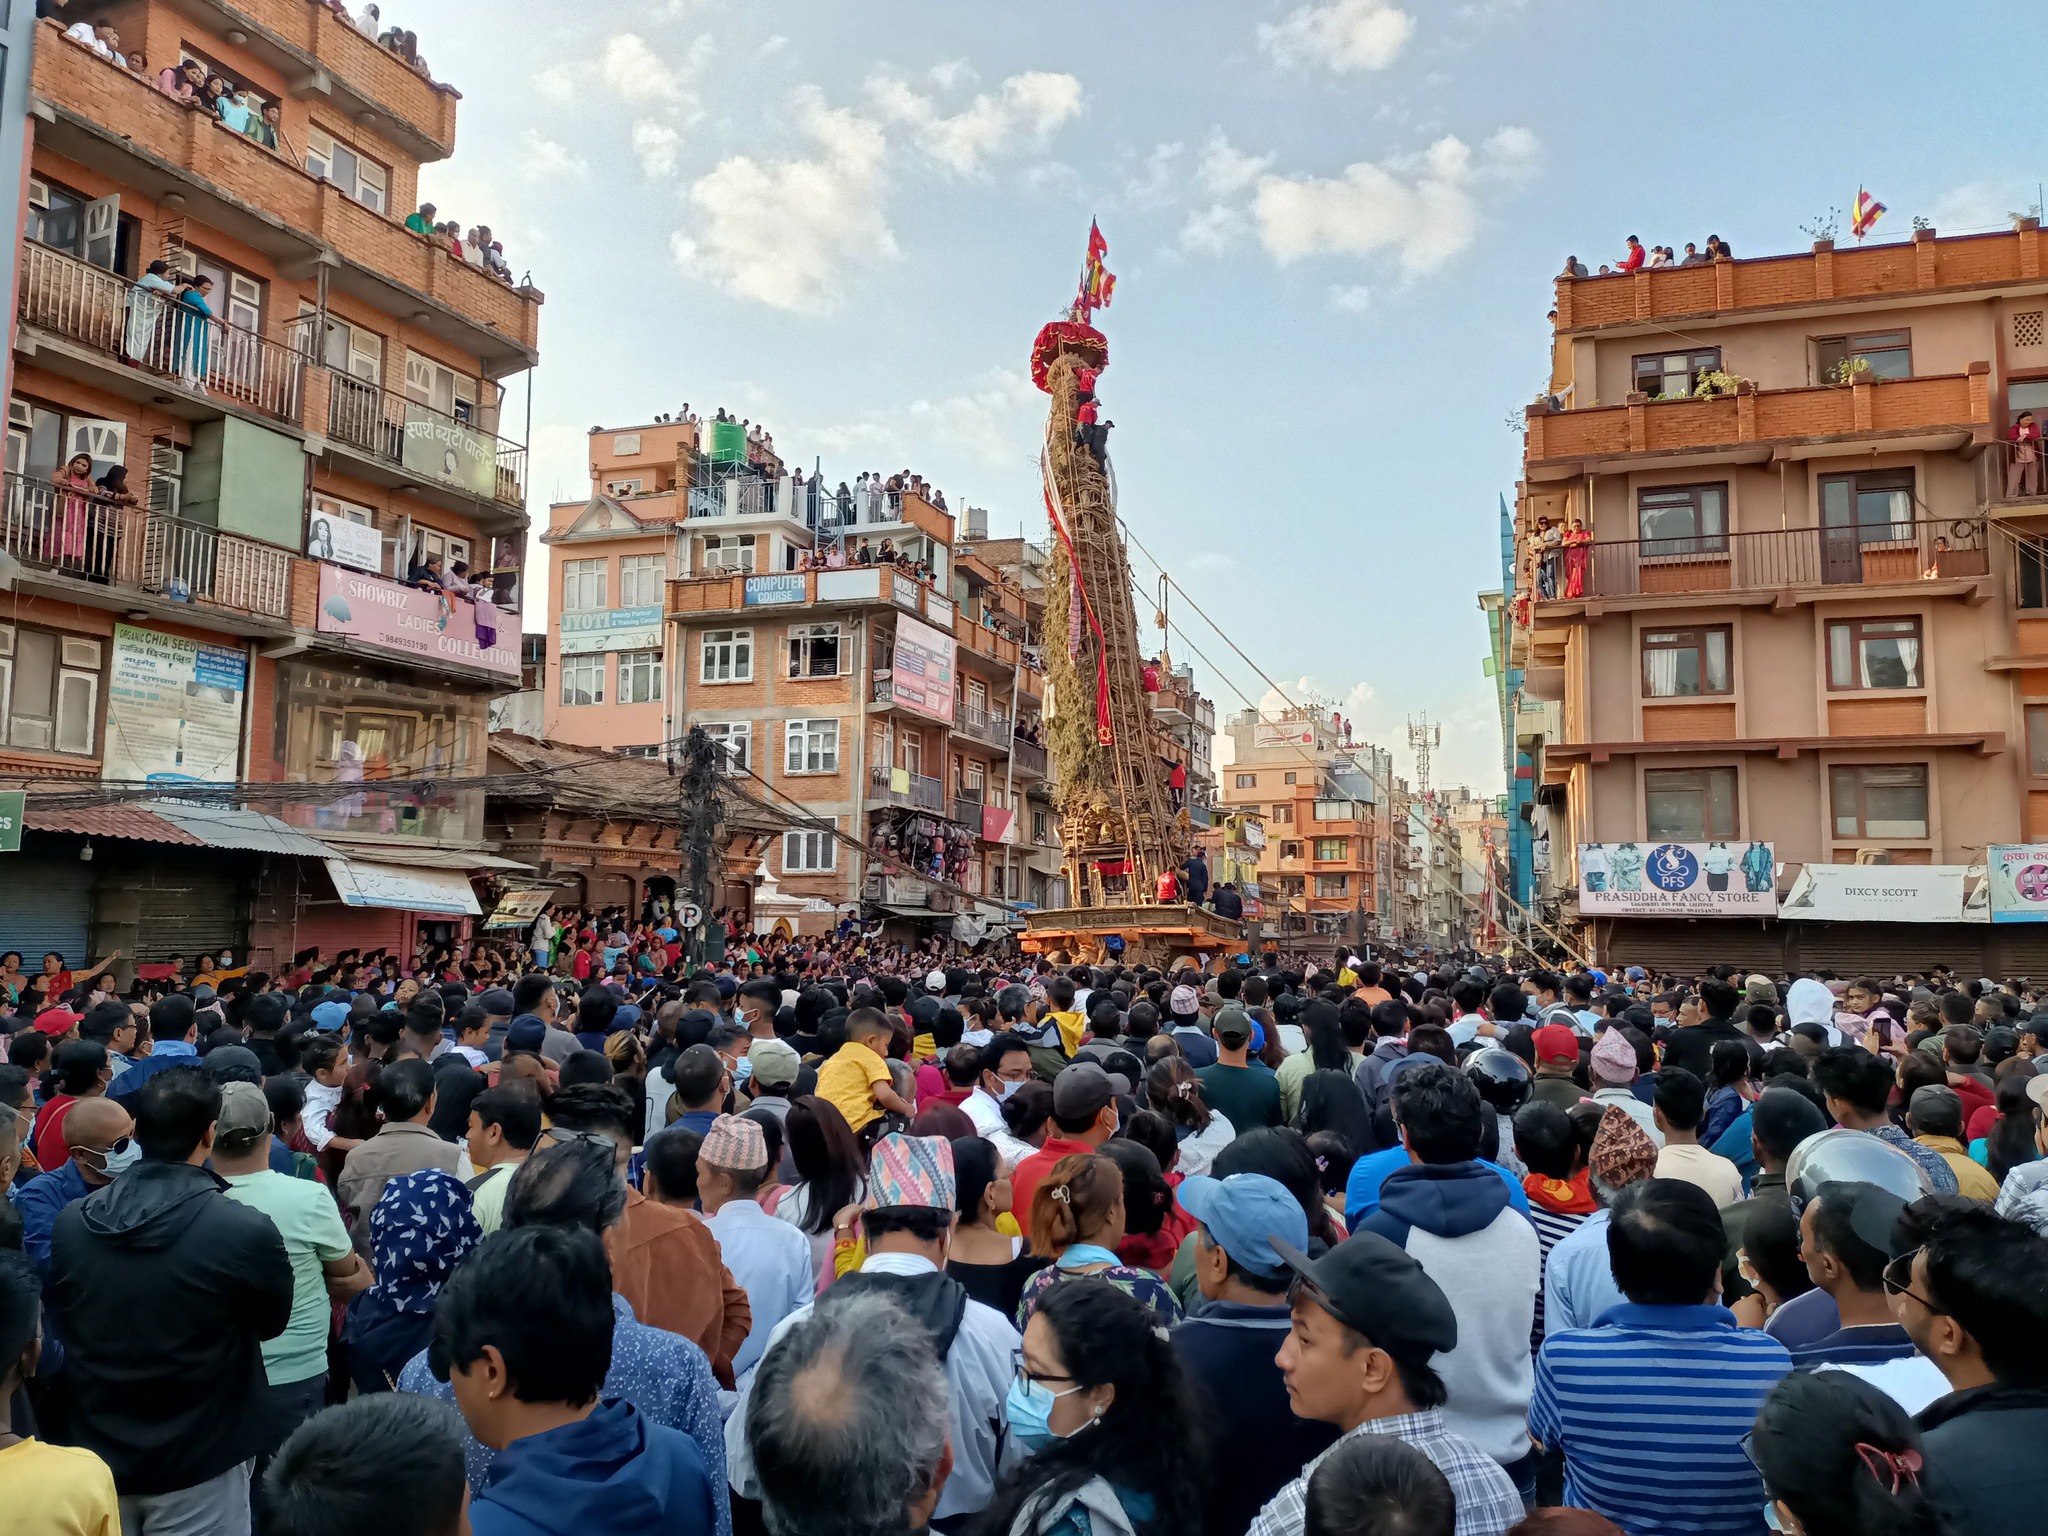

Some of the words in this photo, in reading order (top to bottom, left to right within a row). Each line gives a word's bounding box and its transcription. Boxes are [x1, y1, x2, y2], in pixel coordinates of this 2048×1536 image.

[406, 417, 434, 439] स्पर्श
[435, 425, 464, 449] ब्यूटी
[464, 437, 495, 472] पार्लर
[745, 574, 805, 592] COMPUTER
[894, 574, 918, 599] MOBILE
[349, 579, 409, 611] SHOWBIZ
[757, 590, 793, 602] COURSE
[397, 611, 443, 636] LADIES
[563, 613, 610, 631] JYOTI
[120, 629, 145, 643] ORGANIC
[145, 632, 168, 648] CHIA
[171, 638, 196, 653] SEED
[385, 634, 428, 651] 9849353190
[437, 635, 518, 668] COLLECTION
[1661, 876, 1685, 888] PFS
[1595, 892, 1667, 902] PRASIDDHA
[1672, 892, 1713, 902] FANCY
[1717, 893, 1759, 902] STORE
[1845, 887, 1879, 896] DIXCY
[1882, 888, 1918, 897] SCOTT
